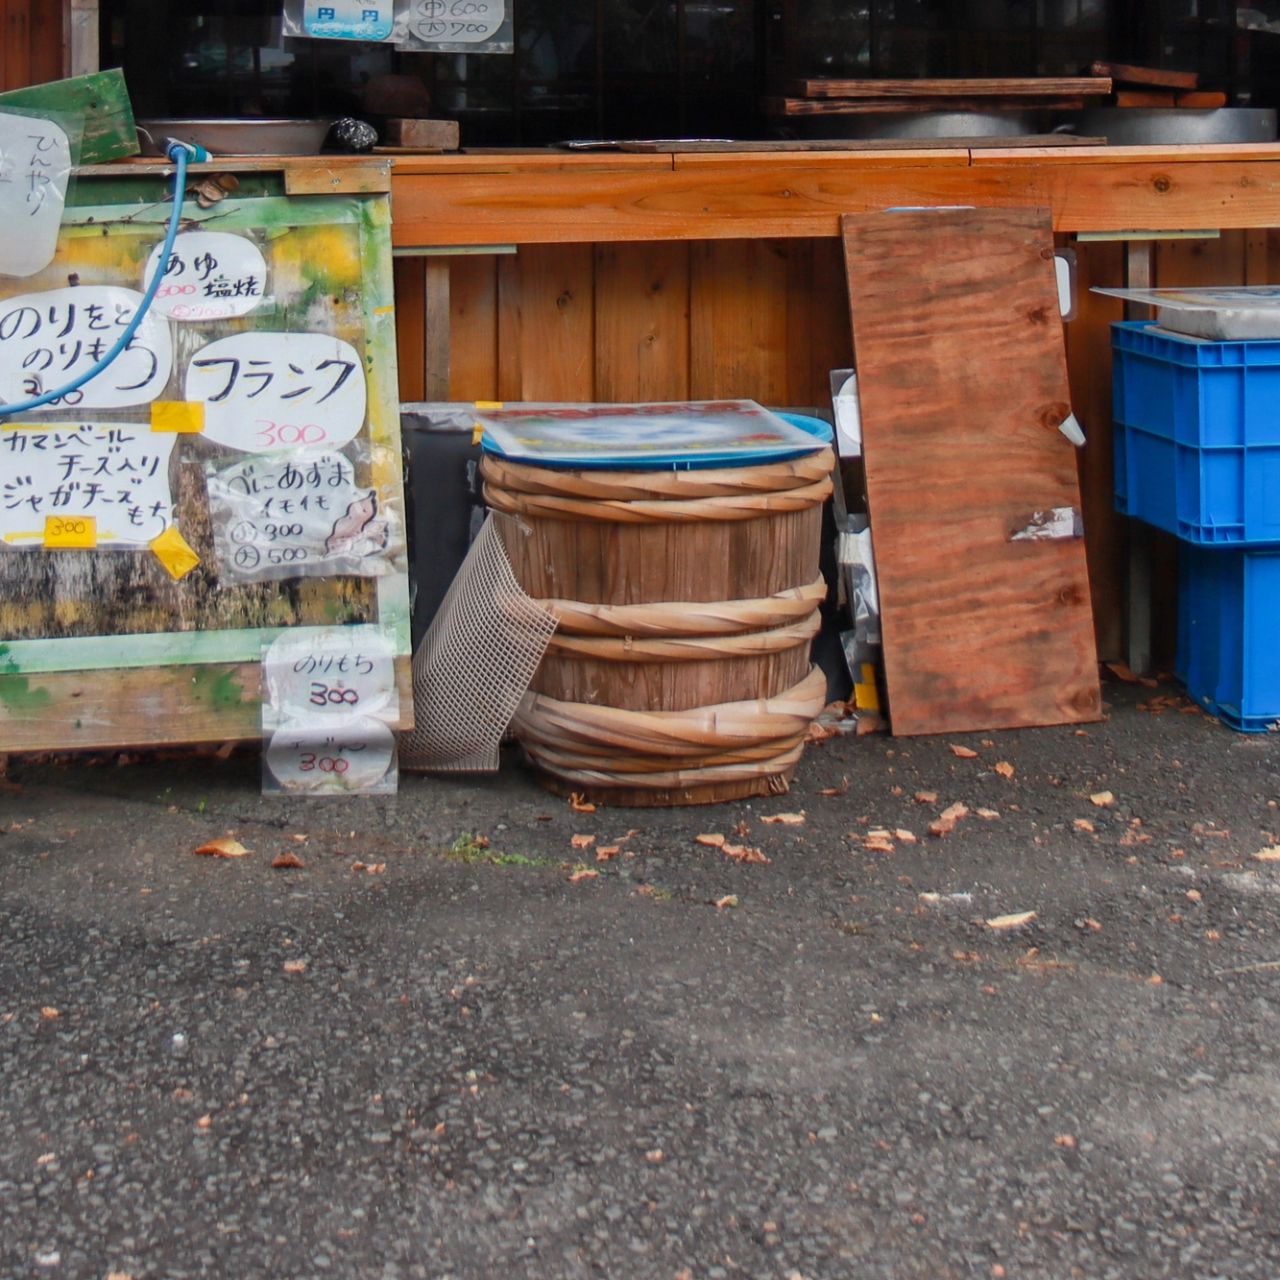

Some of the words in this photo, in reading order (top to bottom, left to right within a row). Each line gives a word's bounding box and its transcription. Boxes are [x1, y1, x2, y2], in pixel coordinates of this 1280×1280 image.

[450, 0, 488, 17] 600
[451, 22, 488, 36] 700
[25, 135, 60, 217] ひんやり
[158, 251, 219, 281] あゆ
[203, 274, 261, 298] 塩焼
[191, 356, 357, 403] フランク
[3, 425, 136, 453] カマンベール
[252, 419, 327, 447] 300
[57, 447, 161, 481] チーズ入り
[227, 455, 352, 496] べにあずま
[3, 475, 143, 513] ジャガチーズ
[51, 517, 86, 536] 300
[128, 501, 168, 541] もち
[264, 523, 304, 541] 300
[267, 548, 308, 564] 500
[293, 654, 374, 675] のりもち
[309, 682, 359, 706] 300
[299, 752, 349, 774] 300
